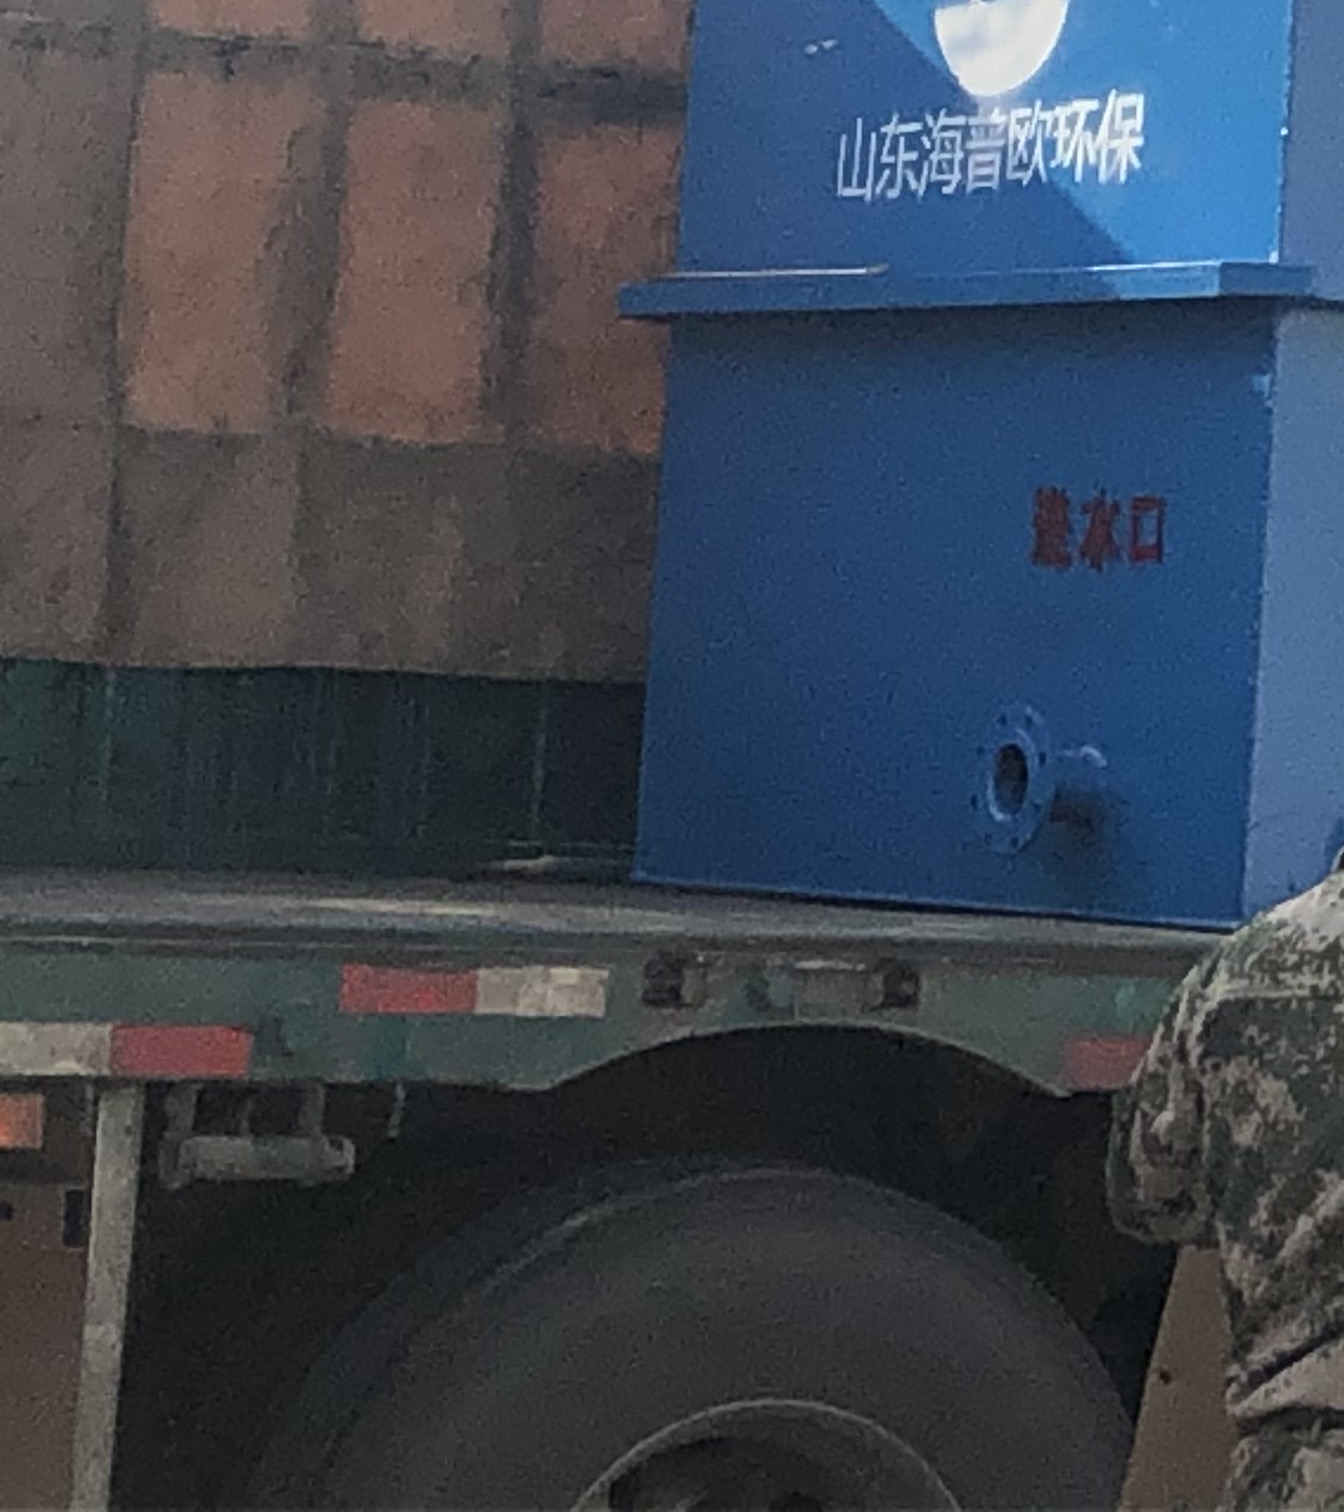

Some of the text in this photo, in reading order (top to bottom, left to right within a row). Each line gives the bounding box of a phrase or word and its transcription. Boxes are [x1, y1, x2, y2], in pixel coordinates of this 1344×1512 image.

[836, 87, 1145, 202] 山东海普欧环保
